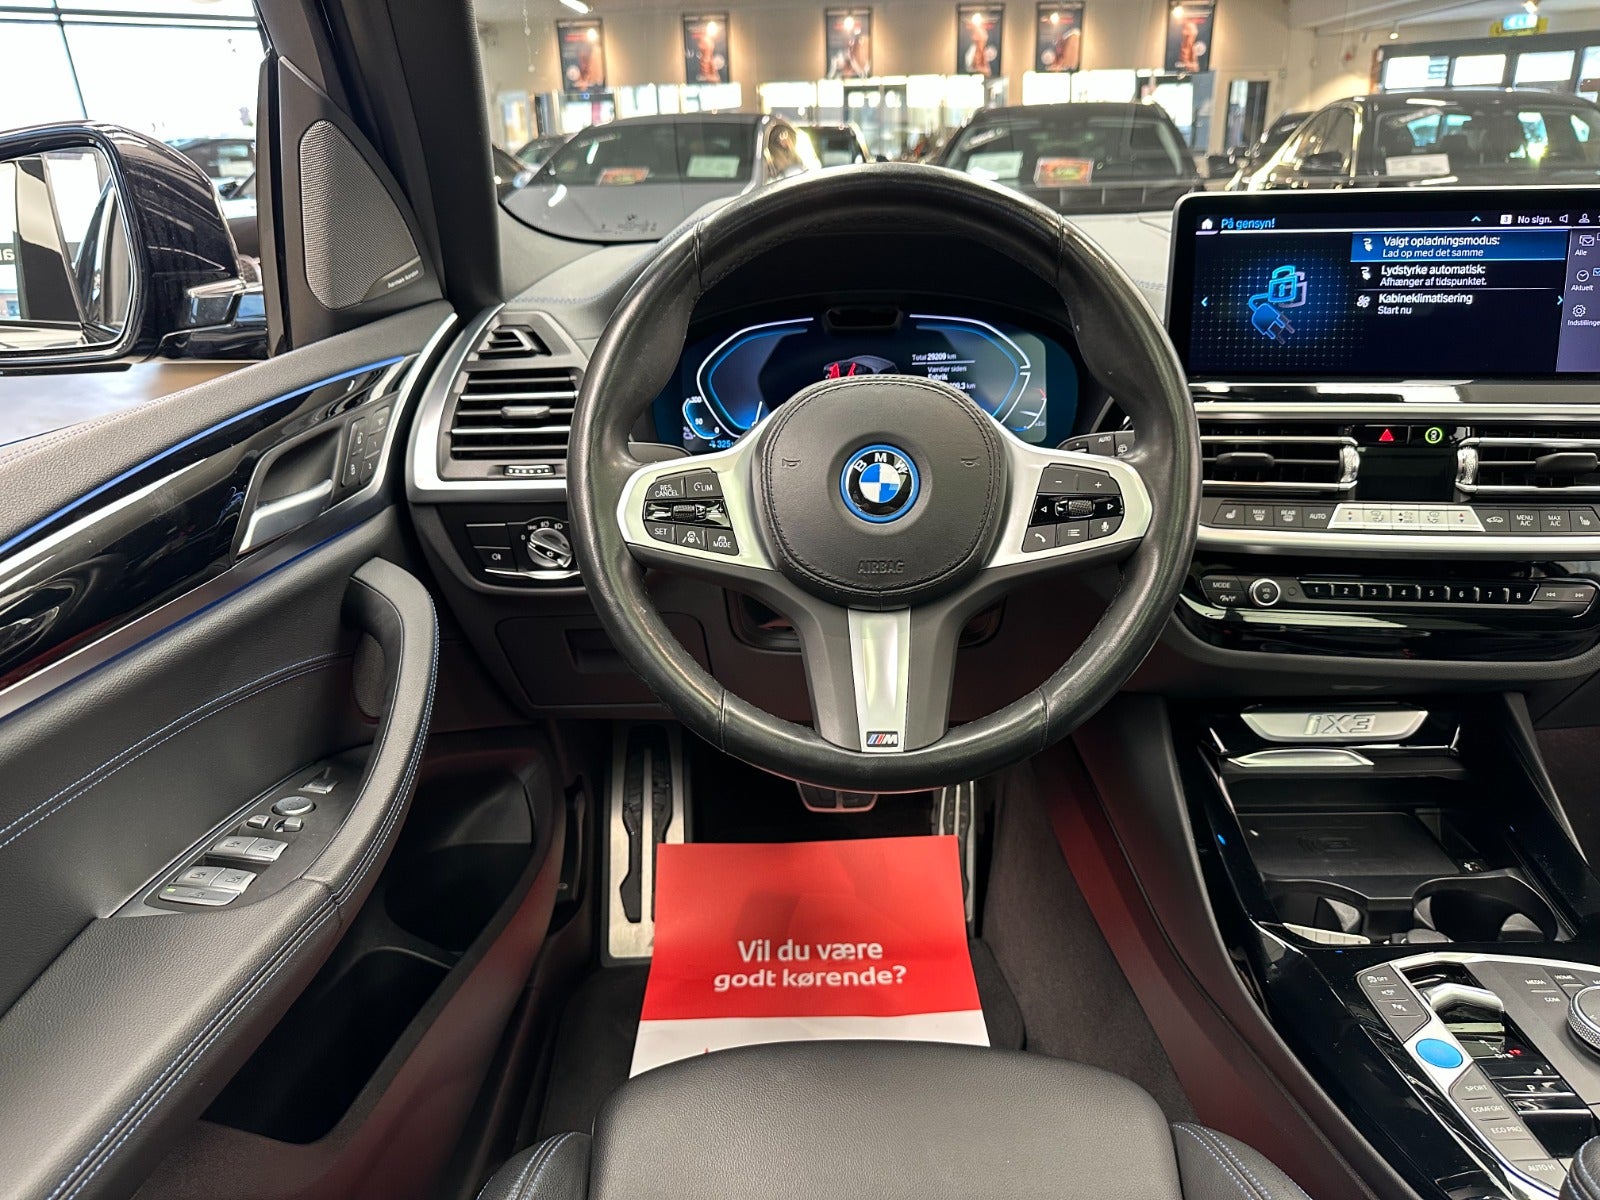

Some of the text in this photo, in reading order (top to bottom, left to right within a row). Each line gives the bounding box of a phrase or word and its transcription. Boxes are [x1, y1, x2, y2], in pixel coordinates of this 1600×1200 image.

[1221, 218, 1276, 230] På gensyn!
[1518, 216, 1530, 224] No
[1532, 216, 1552, 224] sign.
[1384, 236, 1500, 247] Valgt opladningsmodus:
[1383, 249, 1398, 257] Lad
[1400, 250, 1412, 258] op
[1414, 249, 1433, 257] med
[1436, 248, 1450, 256] det
[1381, 264, 1486, 276] Lydstyrke automatisk:
[1380, 276, 1487, 287] Afhænger af tidspunktet.
[1378, 293, 1473, 304] Kabineklimatisering
[1378, 306, 1398, 314] Start
[927, 352, 946, 360] 29209
[718, 440, 731, 448] 325
[854, 452, 910, 474] BMW
[655, 489, 679, 498] CANCEL
[654, 528, 668, 536] SET
[713, 540, 732, 548] MODE
[858, 560, 904, 574] AIRBAG
[738, 939, 883, 962] Vil du være
[714, 965, 907, 992] godt kørende?
[1465, 1084, 1488, 1092] SPORT
[1528, 1164, 1548, 1172] AUTO
